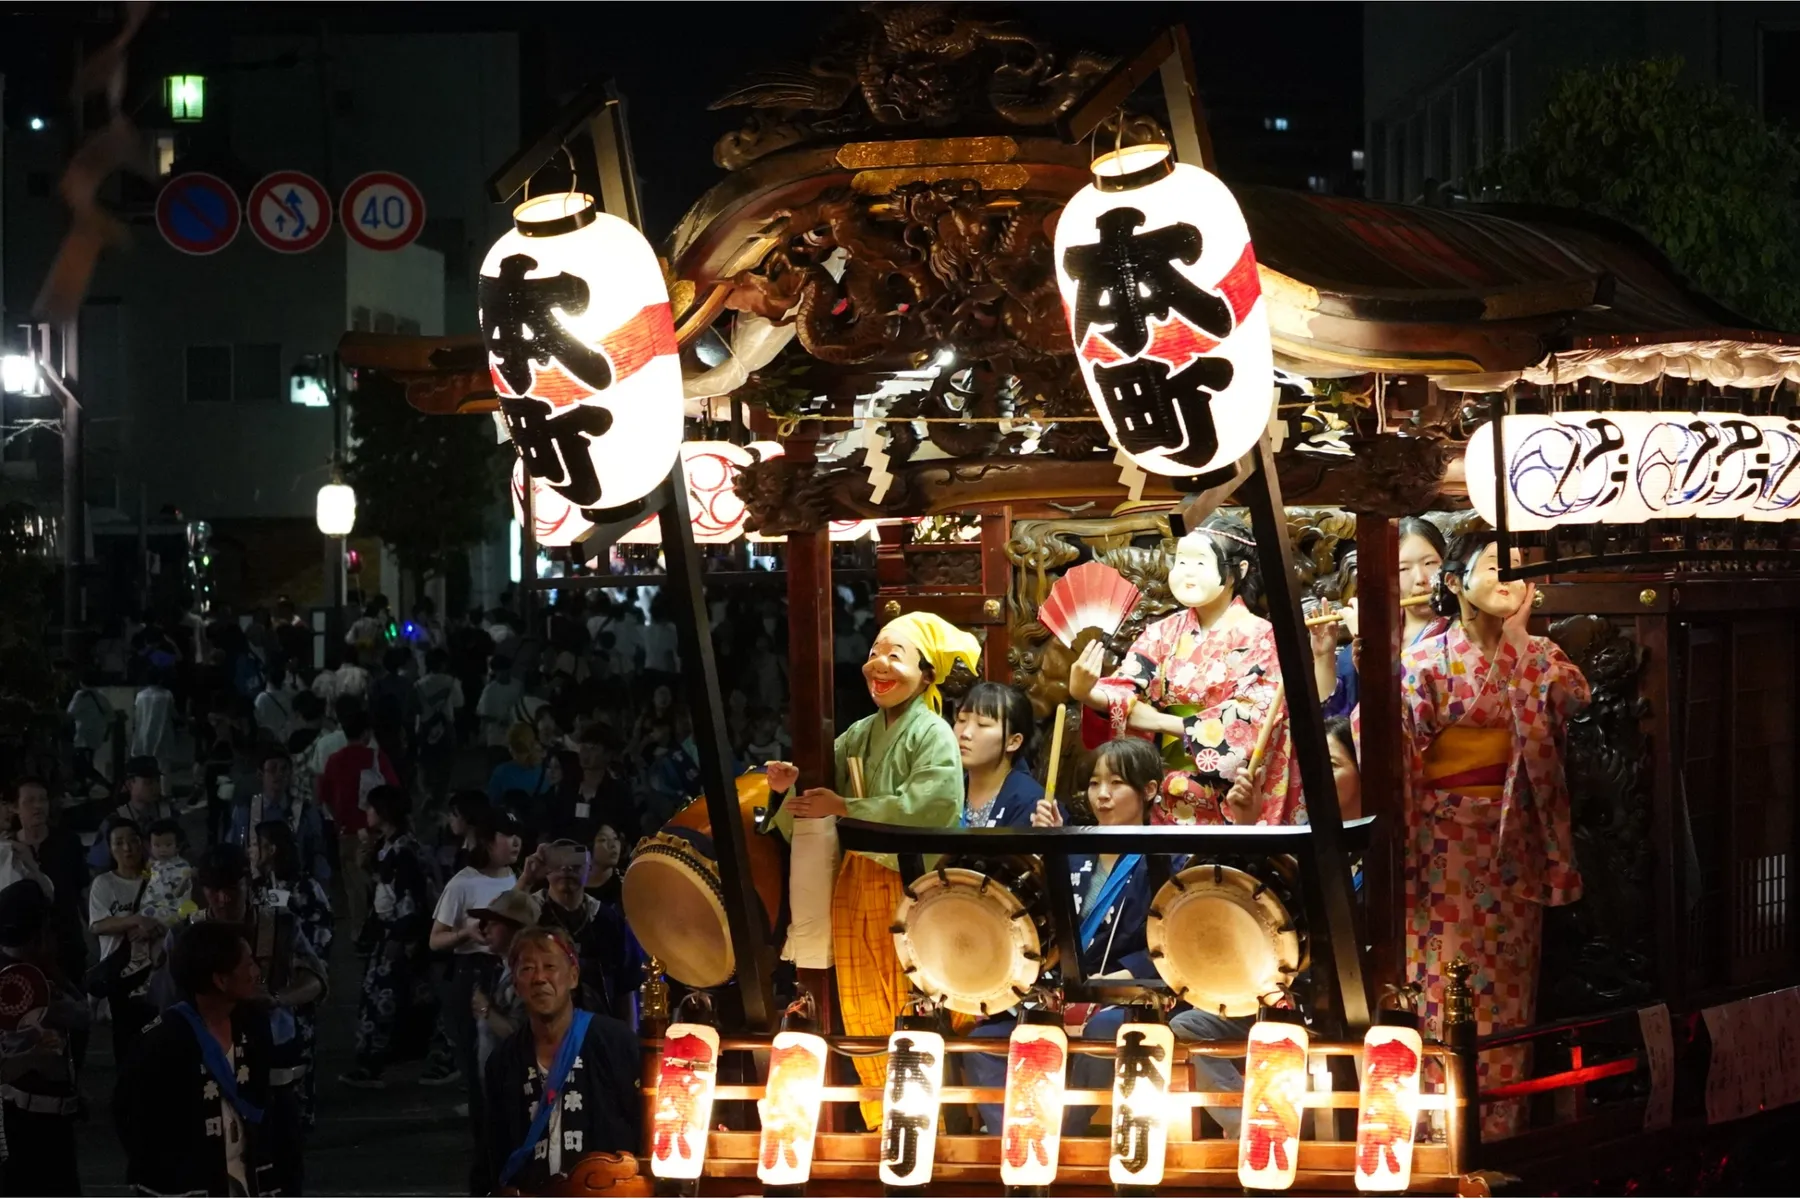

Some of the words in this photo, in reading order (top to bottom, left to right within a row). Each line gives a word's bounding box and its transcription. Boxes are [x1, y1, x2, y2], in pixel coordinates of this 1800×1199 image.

[361, 195, 404, 229] 40
[1063, 206, 1235, 469] 本町
[478, 253, 614, 507] 本町
